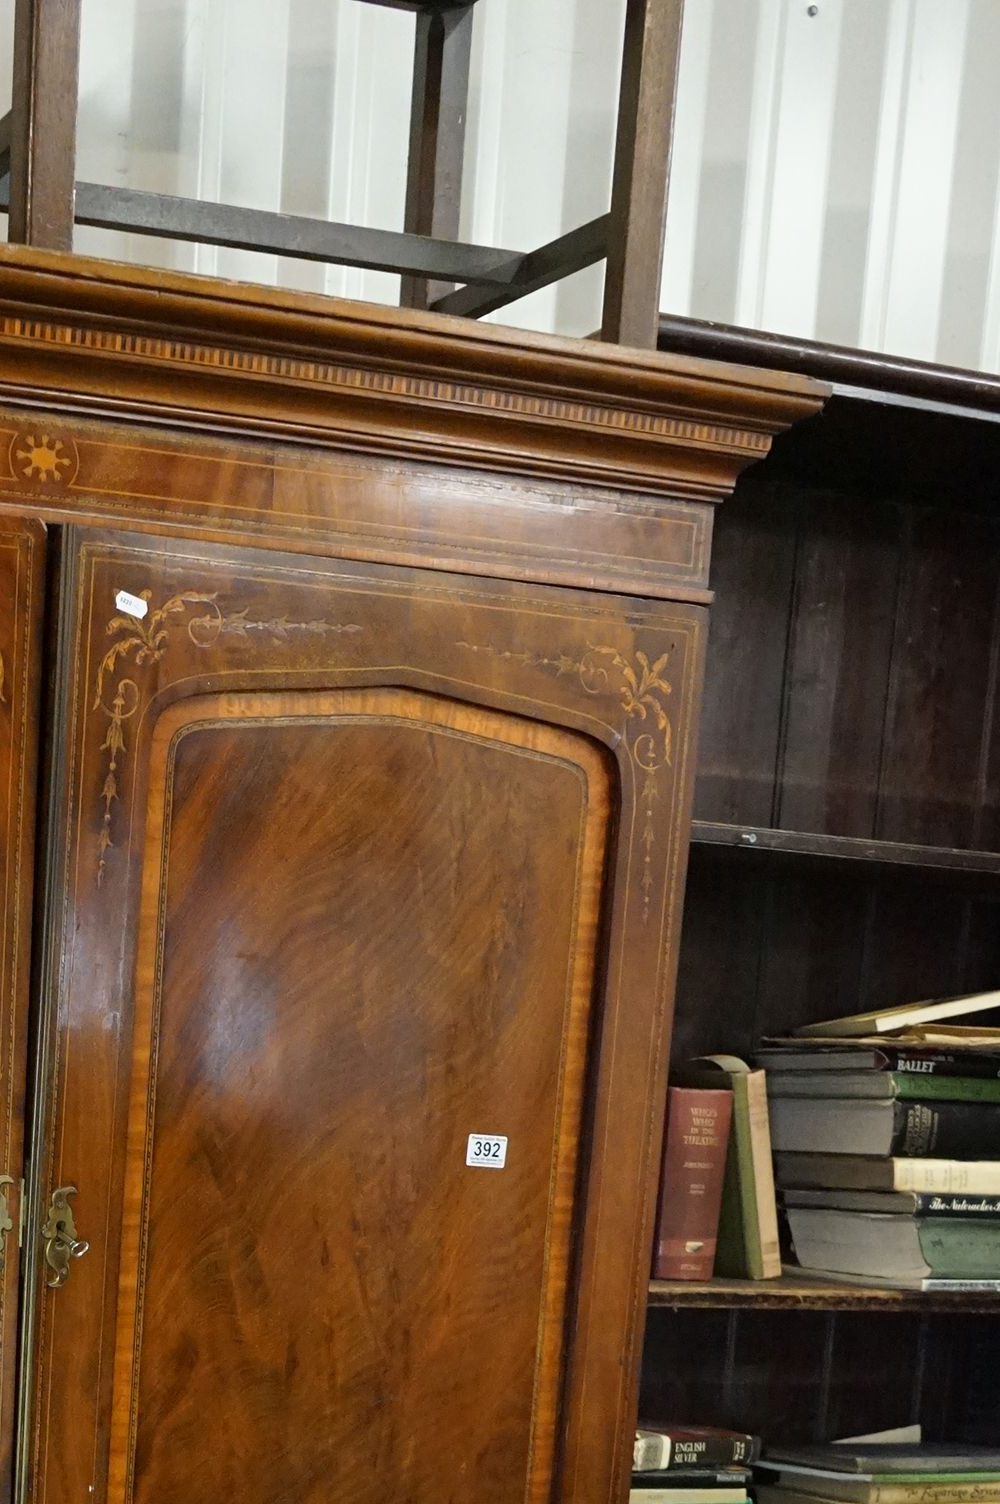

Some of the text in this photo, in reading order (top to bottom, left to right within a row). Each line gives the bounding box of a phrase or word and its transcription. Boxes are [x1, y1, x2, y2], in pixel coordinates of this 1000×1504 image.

[897, 1060, 936, 1073] BALLET
[474, 1141, 501, 1158] 392
[929, 1197, 946, 1210] The
[675, 1442, 706, 1453] ENGLISH
[673, 1453, 698, 1464] SILVER
